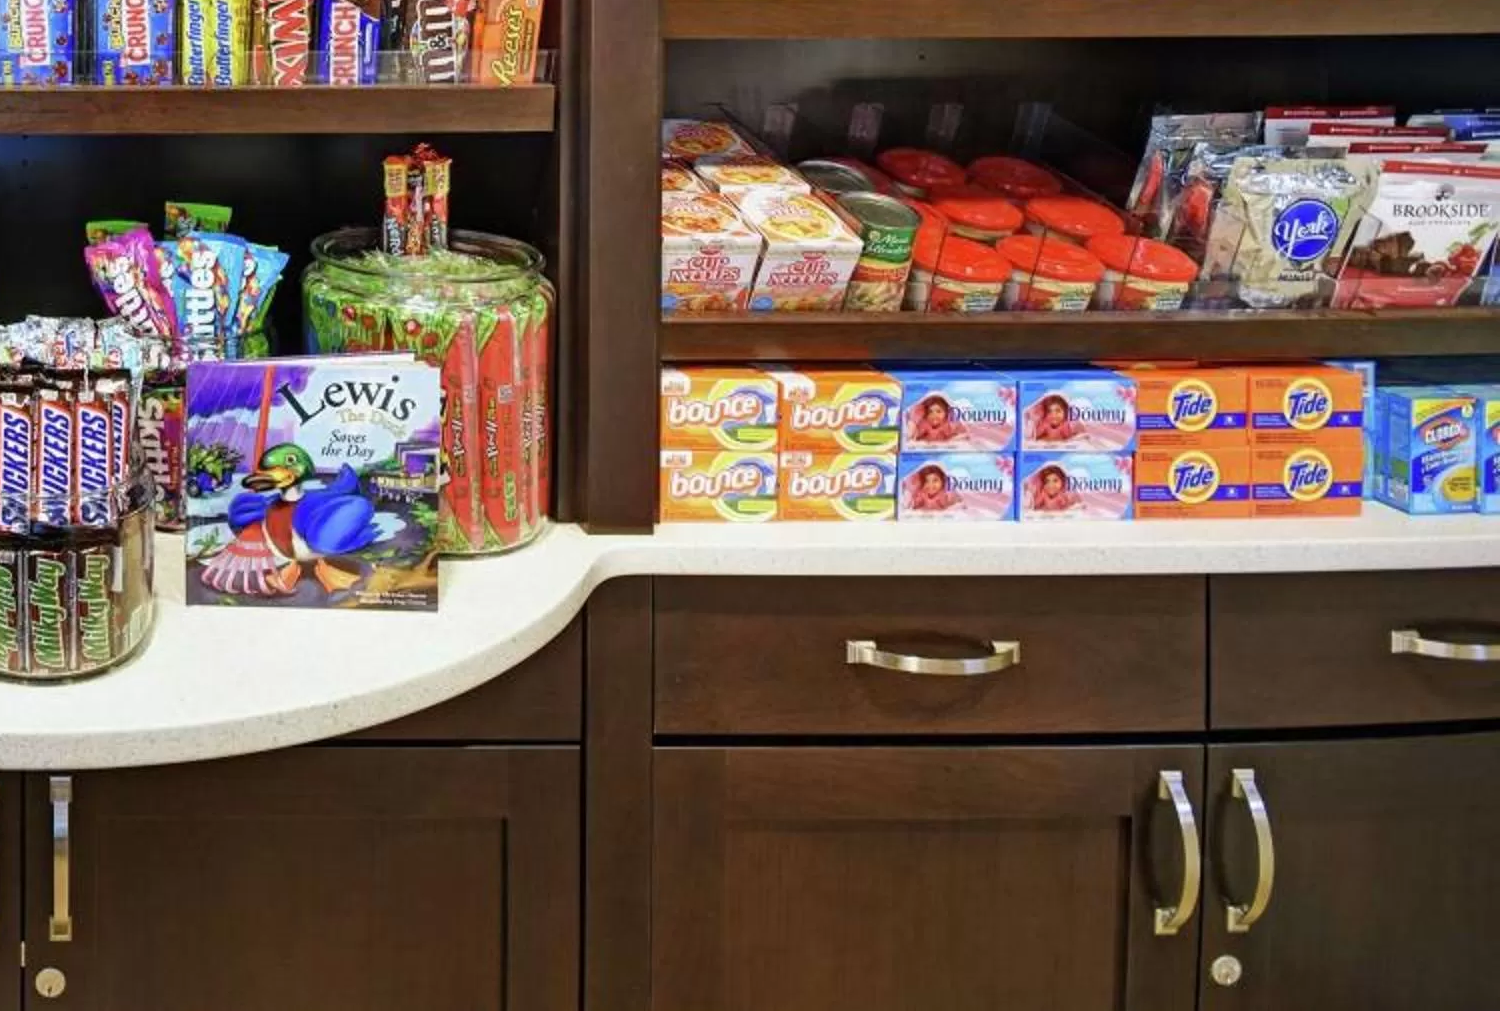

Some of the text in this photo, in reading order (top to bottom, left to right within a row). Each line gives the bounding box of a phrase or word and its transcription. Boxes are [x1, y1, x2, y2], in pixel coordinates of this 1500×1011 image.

[491, 4, 525, 87] Reese's
[1392, 203, 1491, 219] BROOKSIDE
[1274, 210, 1334, 259] York
[276, 374, 418, 427] Lewis
[669, 395, 758, 425] bounce
[792, 399, 882, 429] bounce
[949, 405, 1008, 425] Downy
[1067, 405, 1127, 425] Downy
[1173, 391, 1213, 421] Tide
[1288, 389, 1328, 420] Tide
[337, 409, 365, 424] The
[329, 429, 367, 444] Saves
[320, 442, 376, 462] the Day
[671, 467, 757, 497] bounce
[790, 467, 879, 497] bounce
[945, 475, 1004, 494] Downy
[1065, 475, 1124, 494] Downy
[1174, 464, 1215, 494] Tide
[1288, 462, 1329, 492] Tide
